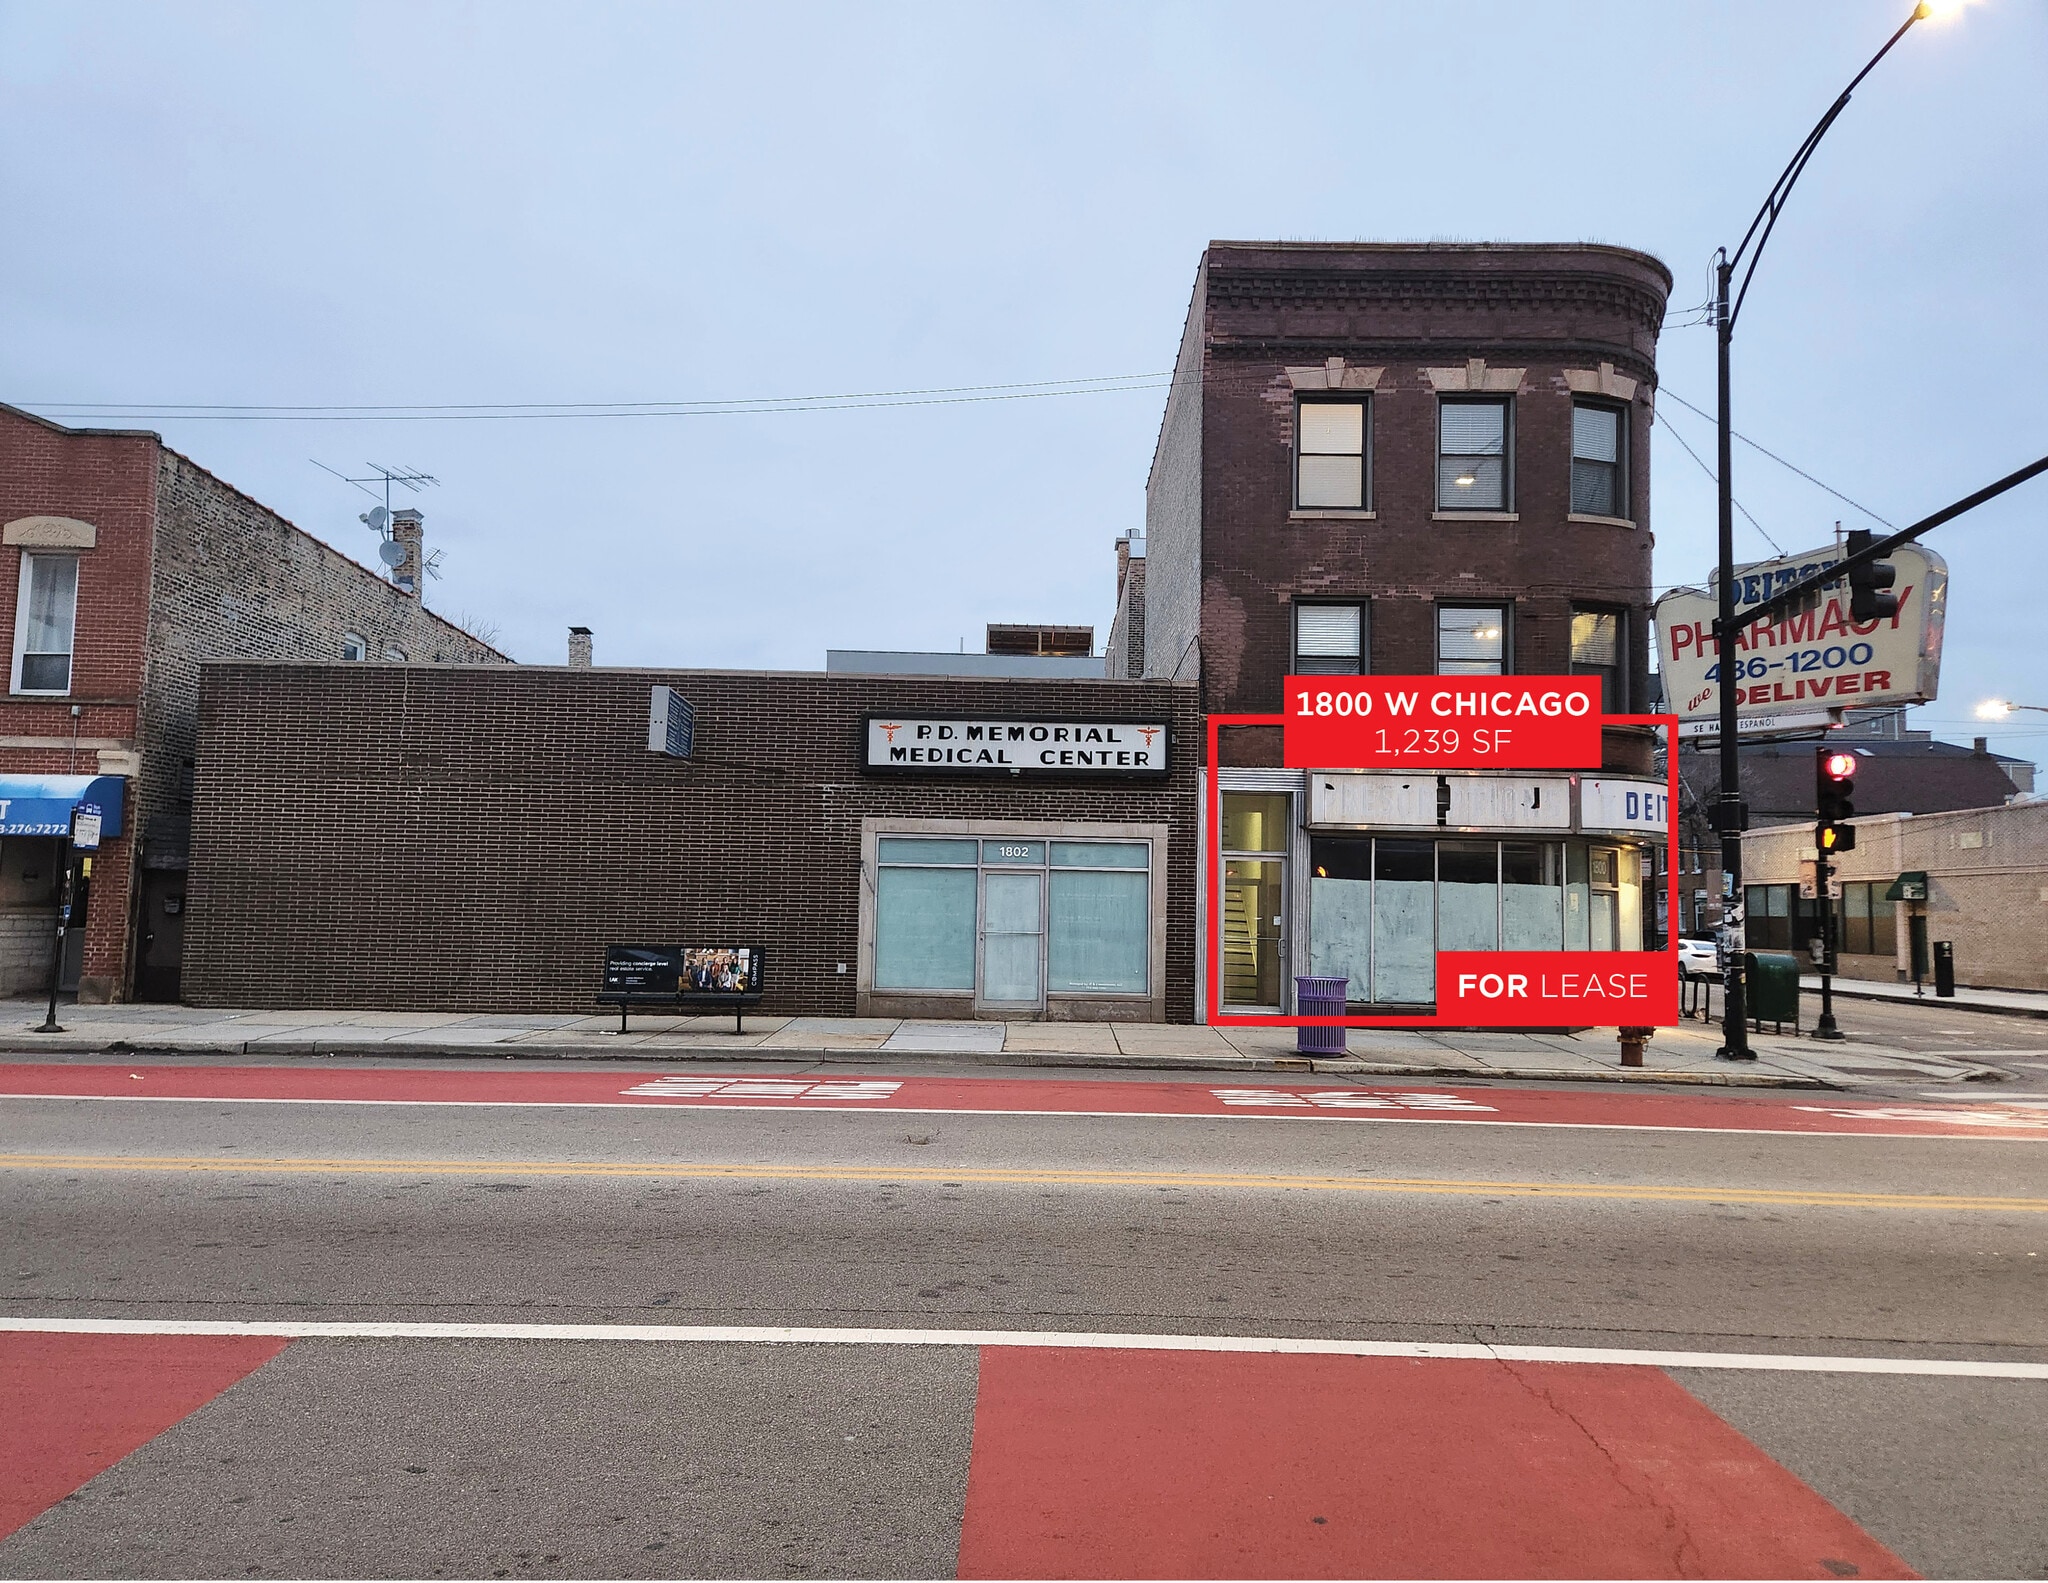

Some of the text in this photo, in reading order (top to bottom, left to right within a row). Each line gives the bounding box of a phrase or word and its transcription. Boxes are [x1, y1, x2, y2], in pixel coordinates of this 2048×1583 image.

[1687, 686, 1713, 712] we
[966, 725, 1123, 743] MEMORIAL
[889, 747, 1150, 767] MEDICAL CENTER
[999, 846, 1029, 858] 1802
[751, 954, 759, 987] COMPASS
